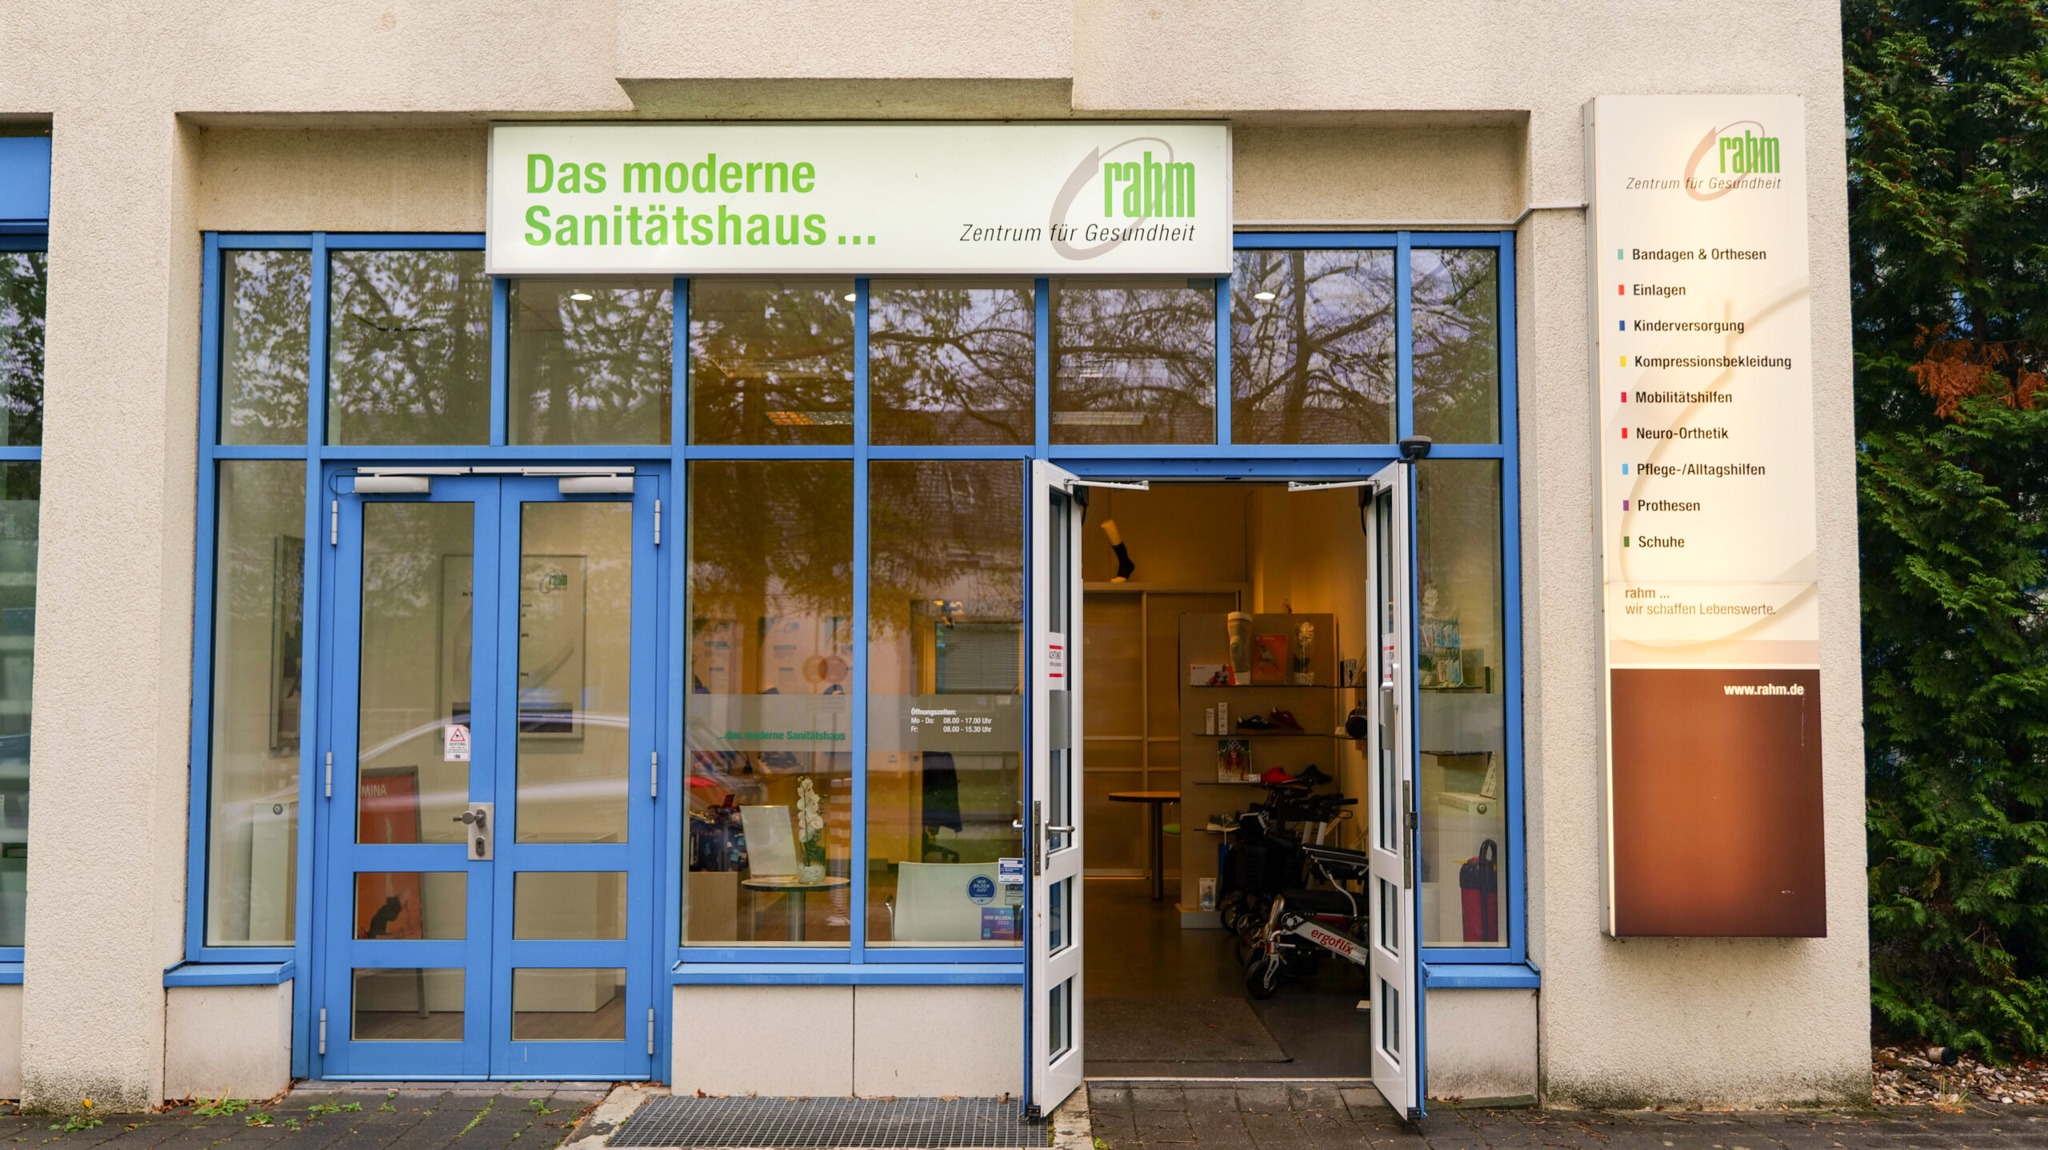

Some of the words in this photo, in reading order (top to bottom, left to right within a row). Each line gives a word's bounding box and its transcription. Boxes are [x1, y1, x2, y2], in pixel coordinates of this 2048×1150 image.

[1719, 130, 1780, 173] rahm
[526, 153, 607, 194] Das
[622, 153, 816, 194] moderne
[1104, 151, 1195, 218] rahm
[1626, 177, 1680, 190] Zentrum
[1685, 177, 1704, 190] für
[1708, 177, 1782, 190] Gesundheit
[524, 204, 827, 246] Sanitätshaus
[960, 223, 1041, 241] Zentrum
[1049, 223, 1078, 241] für
[1085, 223, 1195, 241] Gesundheit
[1632, 248, 1694, 263] Bandagen
[1698, 248, 1707, 261] &
[1711, 248, 1767, 261] Orthesen
[1633, 284, 1686, 299] Einlagen
[1633, 320, 1745, 334] Kinderversorgung
[1634, 355, 1792, 371] Kompressionsbekleidung
[1635, 391, 1733, 404] Mobilitätshilfen
[1636, 427, 1729, 440] Neuro-Orthetik
[1637, 463, 1766, 478] Pflege-/Alltagshilfen
[1637, 500, 1701, 512] Prothesen
[1638, 536, 1685, 548] Schuhe
[1625, 588, 1656, 599] rahm
[1625, 604, 1642, 615] wir
[1646, 604, 1695, 615] schaffen
[1699, 604, 1776, 616] Lebenswerte.
[1723, 684, 1805, 696] www.rahm.de
[911, 707, 957, 716] Öffnungszeiten:
[744, 731, 784, 740] moderne
[786, 730, 846, 741] Sanitätshaus
[1311, 929, 1354, 954] ergoflix
